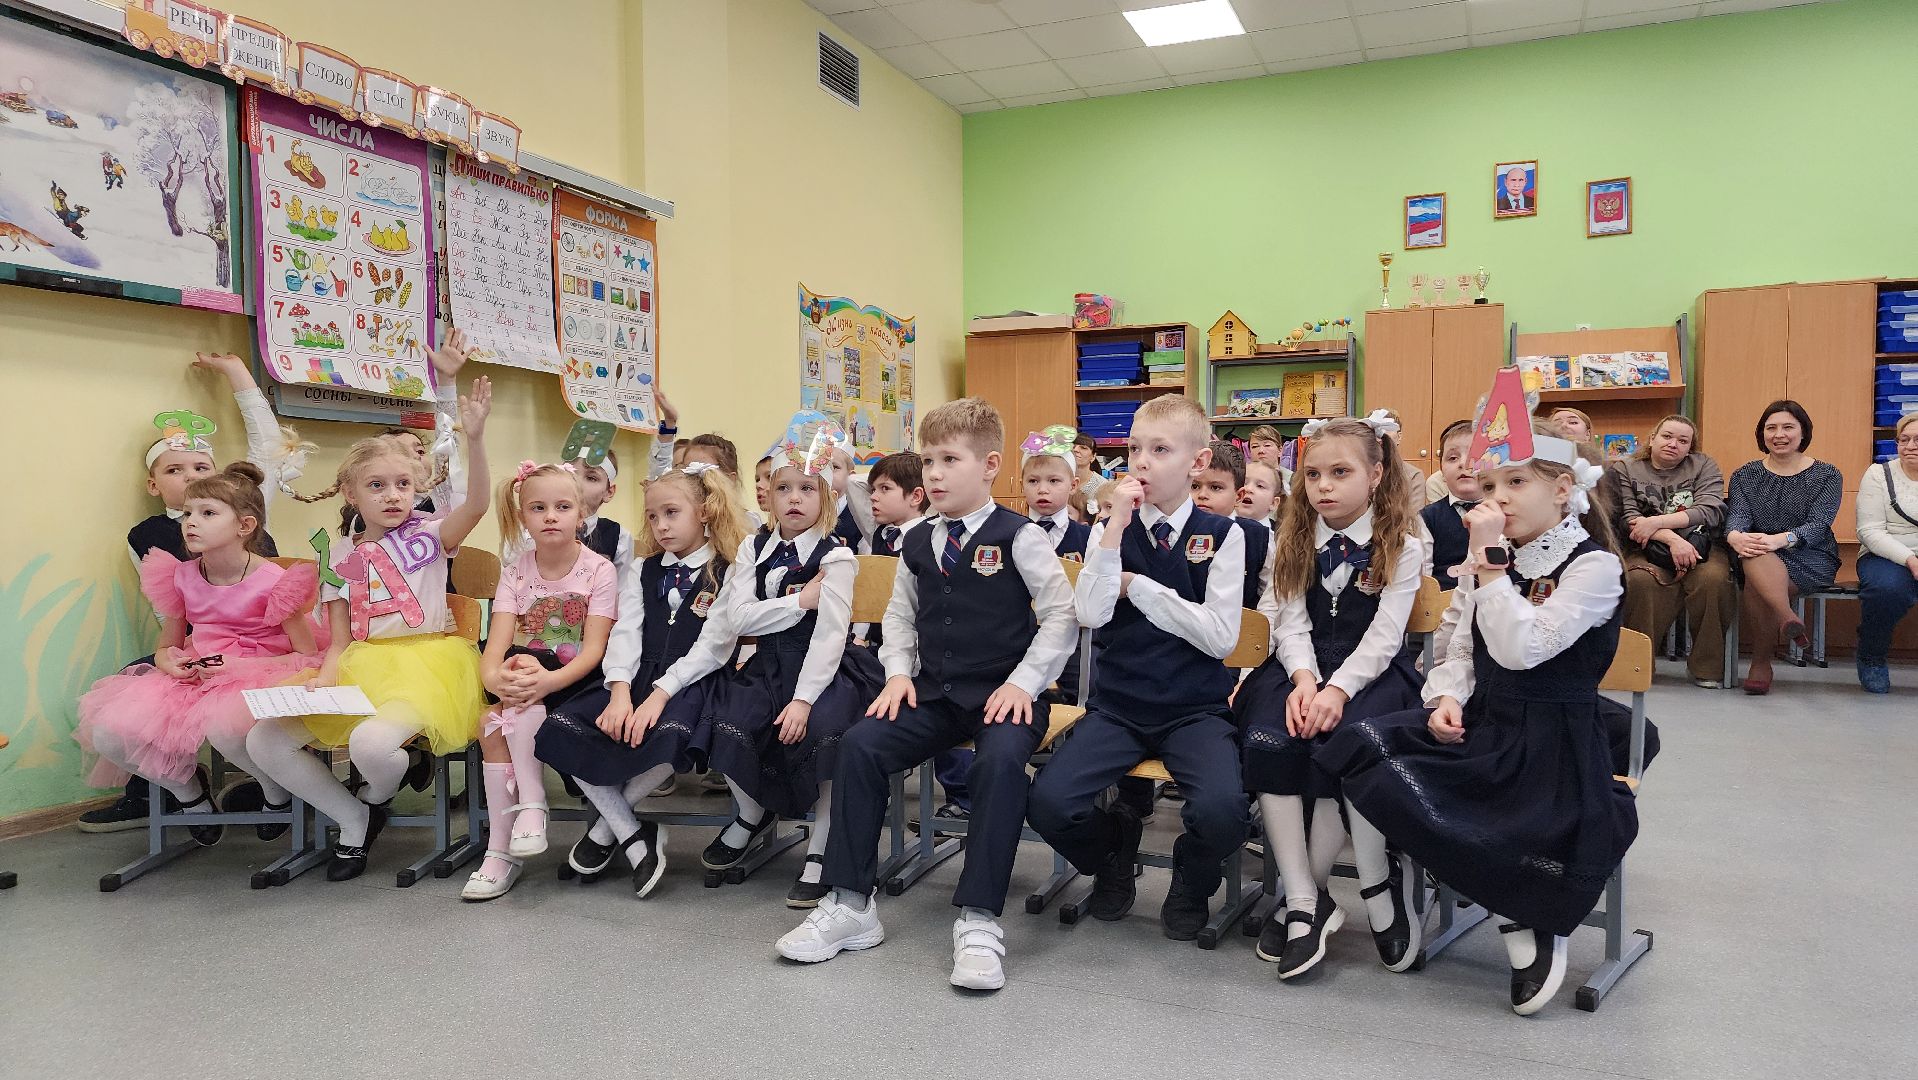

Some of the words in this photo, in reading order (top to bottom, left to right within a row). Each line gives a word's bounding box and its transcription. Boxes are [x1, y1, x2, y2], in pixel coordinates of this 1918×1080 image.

[171, 7, 214, 35] РЕЧЬ
[305, 61, 353, 90] СЛОВО
[373, 89, 407, 109] СЛОГ
[430, 104, 467, 129] БУКВА
[309, 113, 375, 151] ЧИСЛА
[485, 128, 512, 148] ЗВУК
[265, 134, 275, 153] 1
[348, 159, 359, 176] 2
[269, 190, 281, 209] 3
[351, 210, 362, 227] 4
[586, 205, 628, 232] ФОРМА
[272, 245, 283, 263] 5
[353, 261, 364, 278] 6
[274, 301, 284, 318] 7
[356, 314, 366, 330] 8
[279, 354, 293, 372] 9
[361, 363, 382, 380] 10
[1466, 365, 1534, 470] А
[385, 517, 440, 574] Б
[349, 541, 425, 641] А
